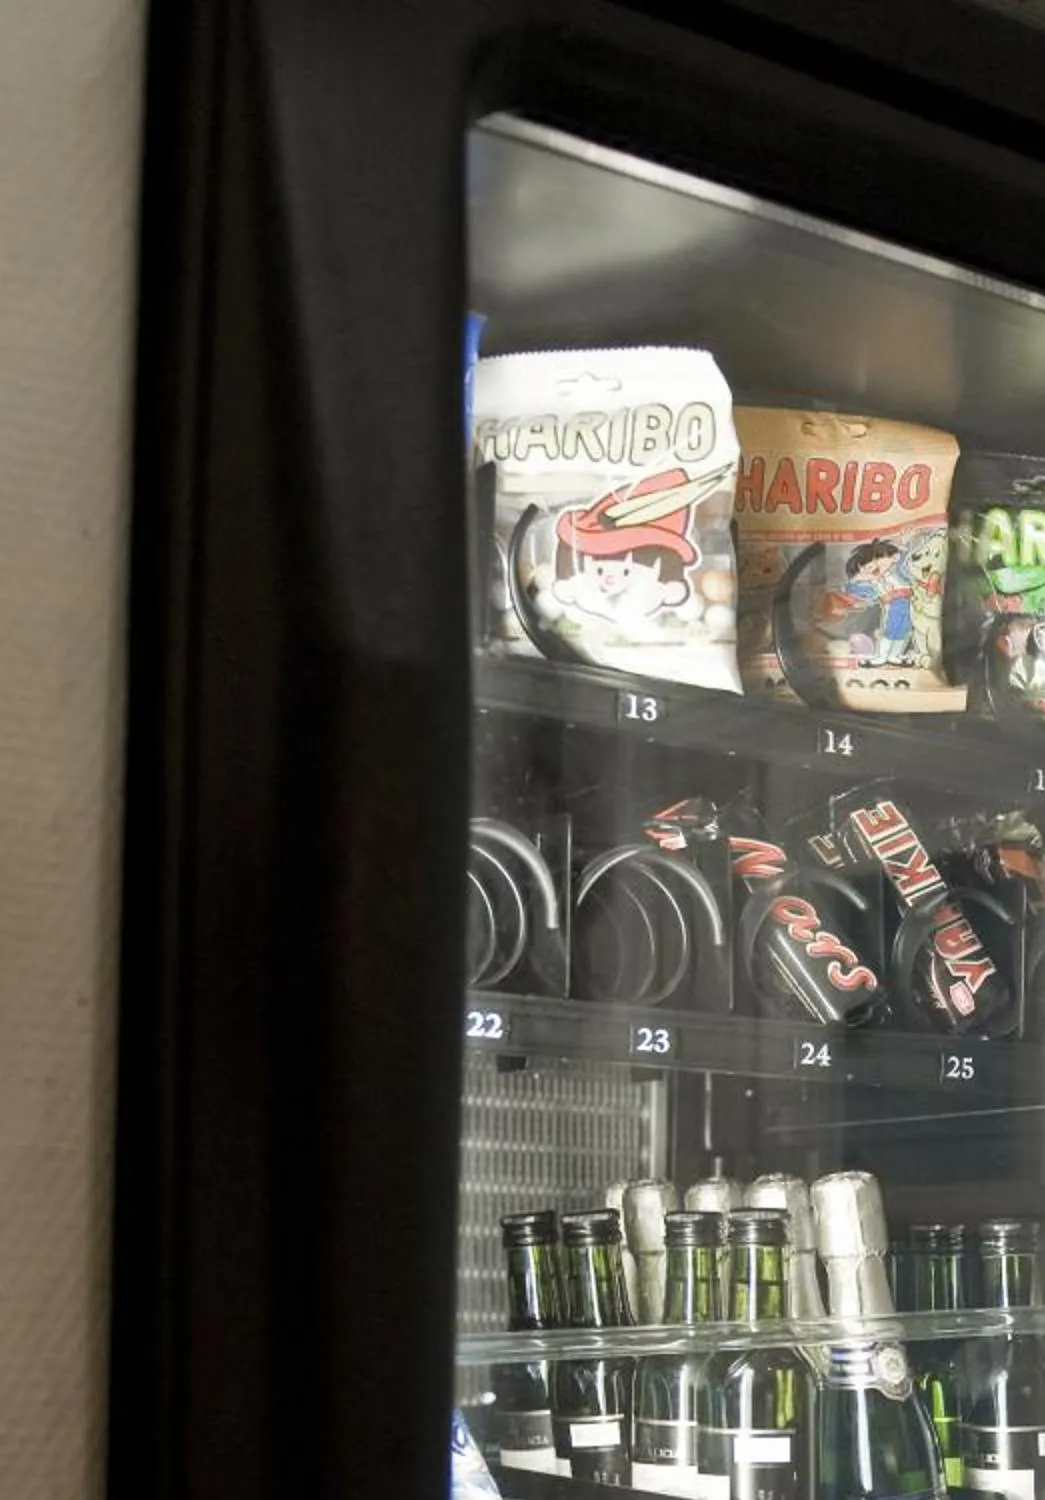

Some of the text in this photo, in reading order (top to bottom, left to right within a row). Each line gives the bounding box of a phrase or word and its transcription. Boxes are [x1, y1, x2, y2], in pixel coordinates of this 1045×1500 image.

[476, 401, 717, 467] HARIBO
[736, 456, 933, 515] HARIBO
[624, 694, 658, 721] 13
[822, 729, 854, 756] 14
[466, 1011, 503, 1039] 22
[637, 1028, 670, 1053] 23
[801, 1042, 832, 1067] 24
[946, 1056, 975, 1079] 25
